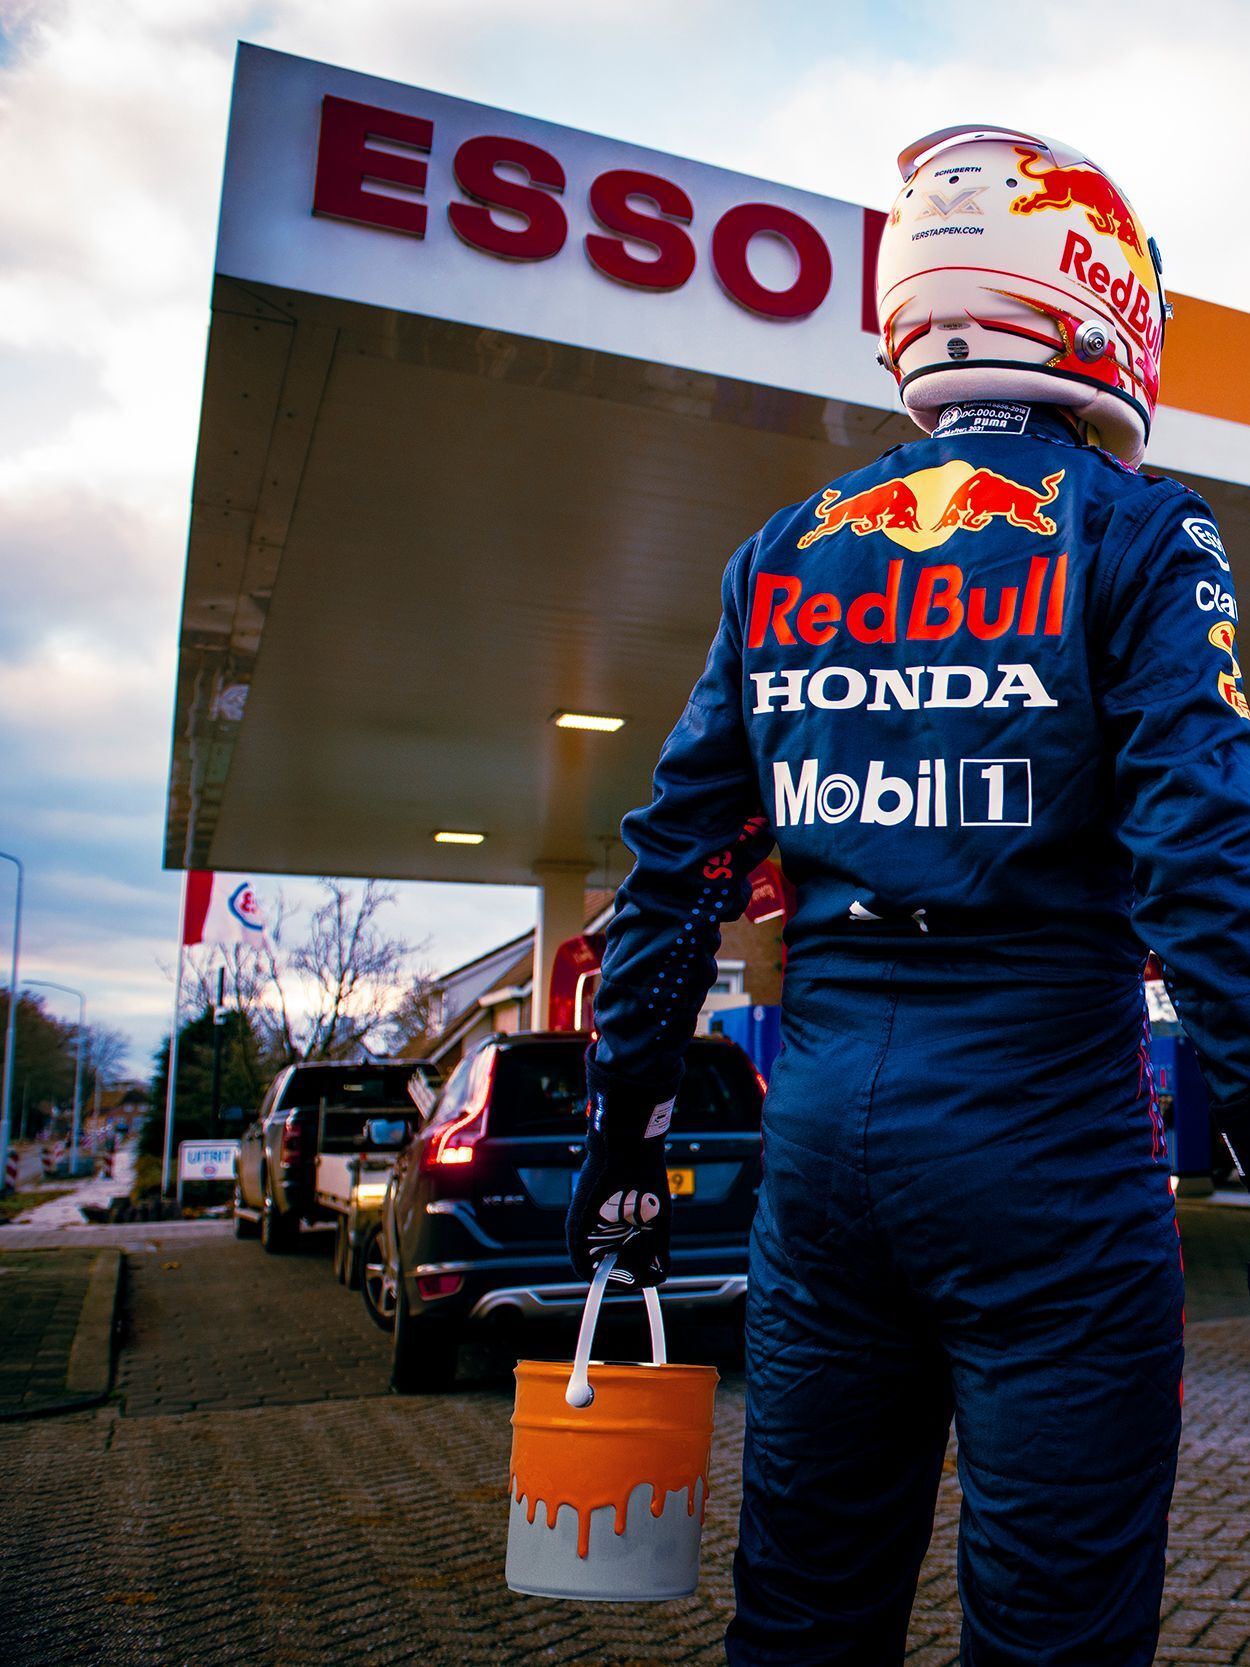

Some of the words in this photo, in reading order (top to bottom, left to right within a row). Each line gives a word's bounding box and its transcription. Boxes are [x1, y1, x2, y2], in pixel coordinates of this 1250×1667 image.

[934, 166, 982, 178] SCHUBERTH
[311, 93, 833, 320] ESSO
[911, 226, 985, 241] VERSTAPPEN.COM
[973, 418, 1008, 428] PUMA
[749, 663, 1058, 715] HONDA
[773, 758, 947, 827] Mobil
